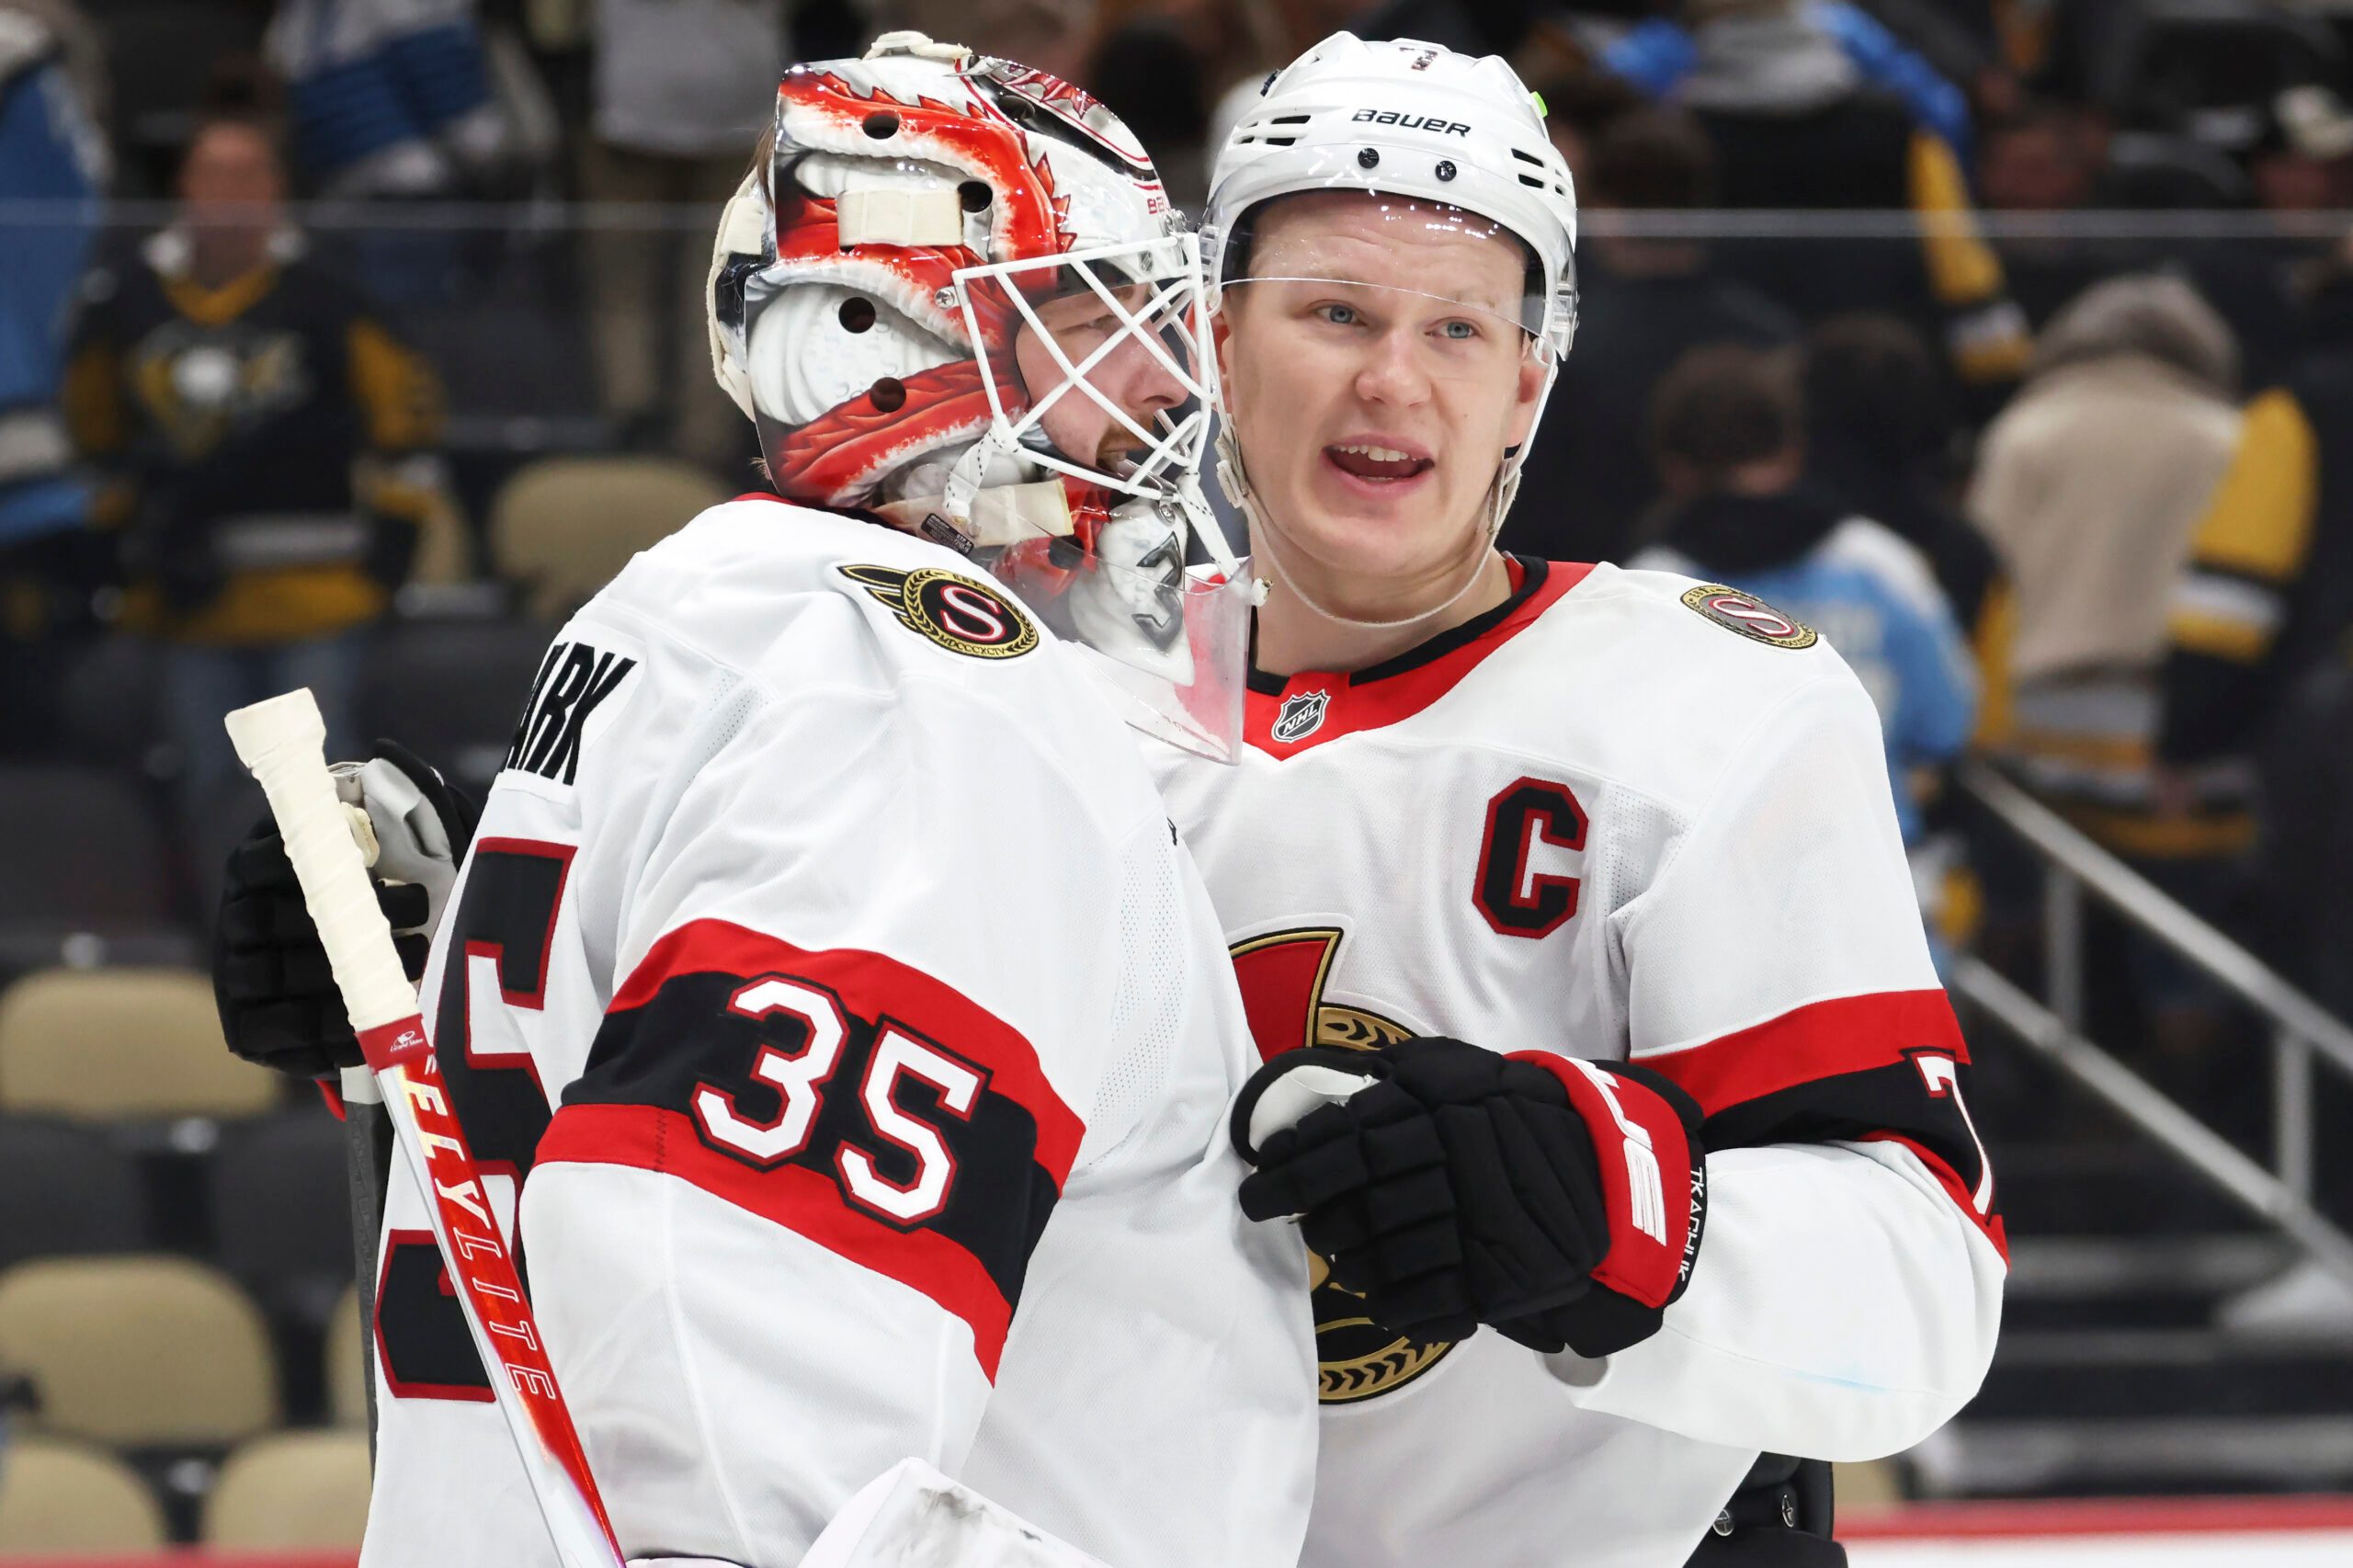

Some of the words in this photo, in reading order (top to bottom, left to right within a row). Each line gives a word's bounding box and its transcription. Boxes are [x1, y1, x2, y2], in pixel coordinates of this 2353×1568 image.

[1351, 108, 1472, 138] BAUER
[1282, 704, 1318, 734] NHL
[1472, 776, 1589, 940] C
[689, 972, 993, 1228] 35
